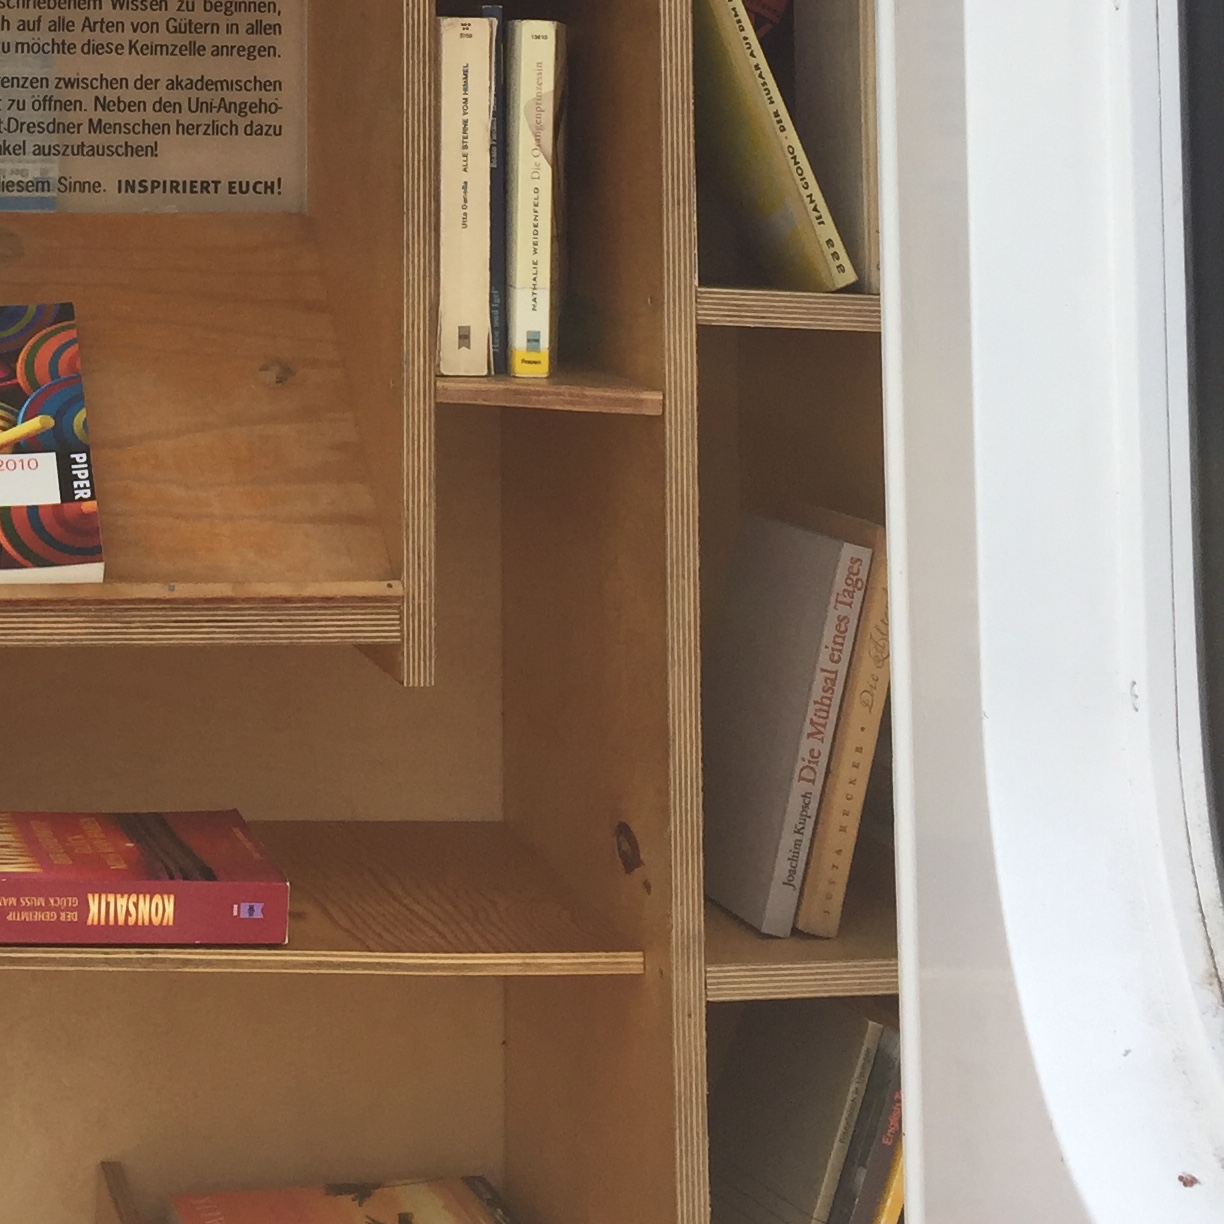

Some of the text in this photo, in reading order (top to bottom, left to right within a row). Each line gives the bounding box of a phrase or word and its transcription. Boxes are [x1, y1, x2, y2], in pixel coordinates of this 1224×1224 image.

[729, 5, 746, 33] DEM
[740, 34, 757, 60] AUF
[53, 72, 130, 92] zwischen
[132, 72, 162, 92] der
[164, 73, 283, 93] akademischen
[752, 62, 775, 105] HUSAR
[771, 108, 787, 133] DER
[31, 138, 159, 158] auszutauschen!
[530, 161, 540, 180] Die
[784, 143, 811, 190] GIONO
[56, 174, 107, 194] Sinne.
[116, 175, 223, 195] INSPIRIERT
[227, 175, 283, 195] EUCH!
[805, 192, 826, 227] JEAN
[70, 452, 91, 500] PIPER
[797, 555, 868, 786] Die Mühsal eines Tages
[781, 790, 814, 890] Joachim Kupsch
[20, 895, 46, 907] MUSS
[49, 896, 78, 909] GLÜCK
[86, 893, 175, 926] KONSALIK
[6, 910, 78, 923] DER GEHEIMTIP
